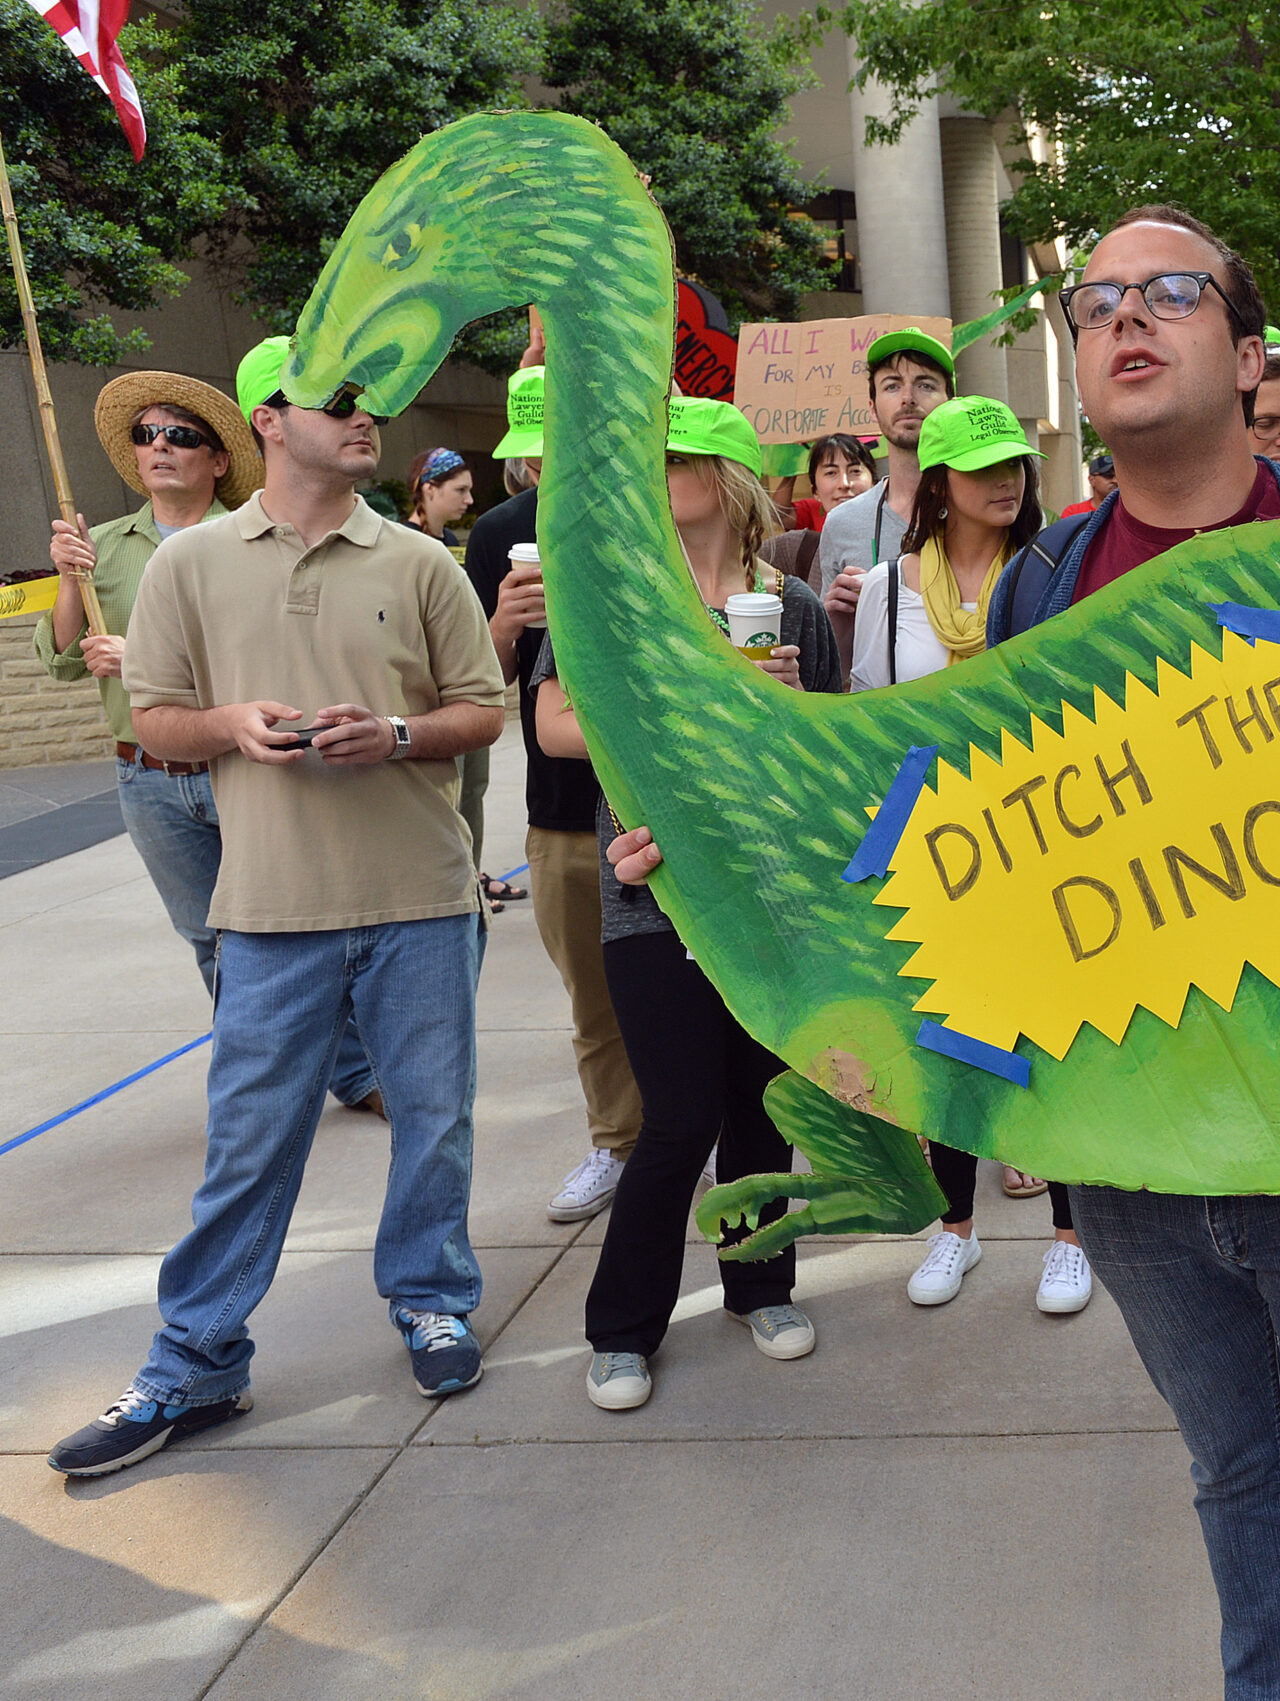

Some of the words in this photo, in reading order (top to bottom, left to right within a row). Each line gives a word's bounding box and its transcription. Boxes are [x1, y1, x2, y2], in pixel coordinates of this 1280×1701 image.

[747, 327, 793, 355] ALL
[805, 329, 824, 355] I
[764, 363, 794, 384] FOR
[804, 363, 835, 381] MY
[510, 394, 545, 402] Nation
[823, 384, 842, 397] IS
[925, 738, 1153, 901] DITCH
